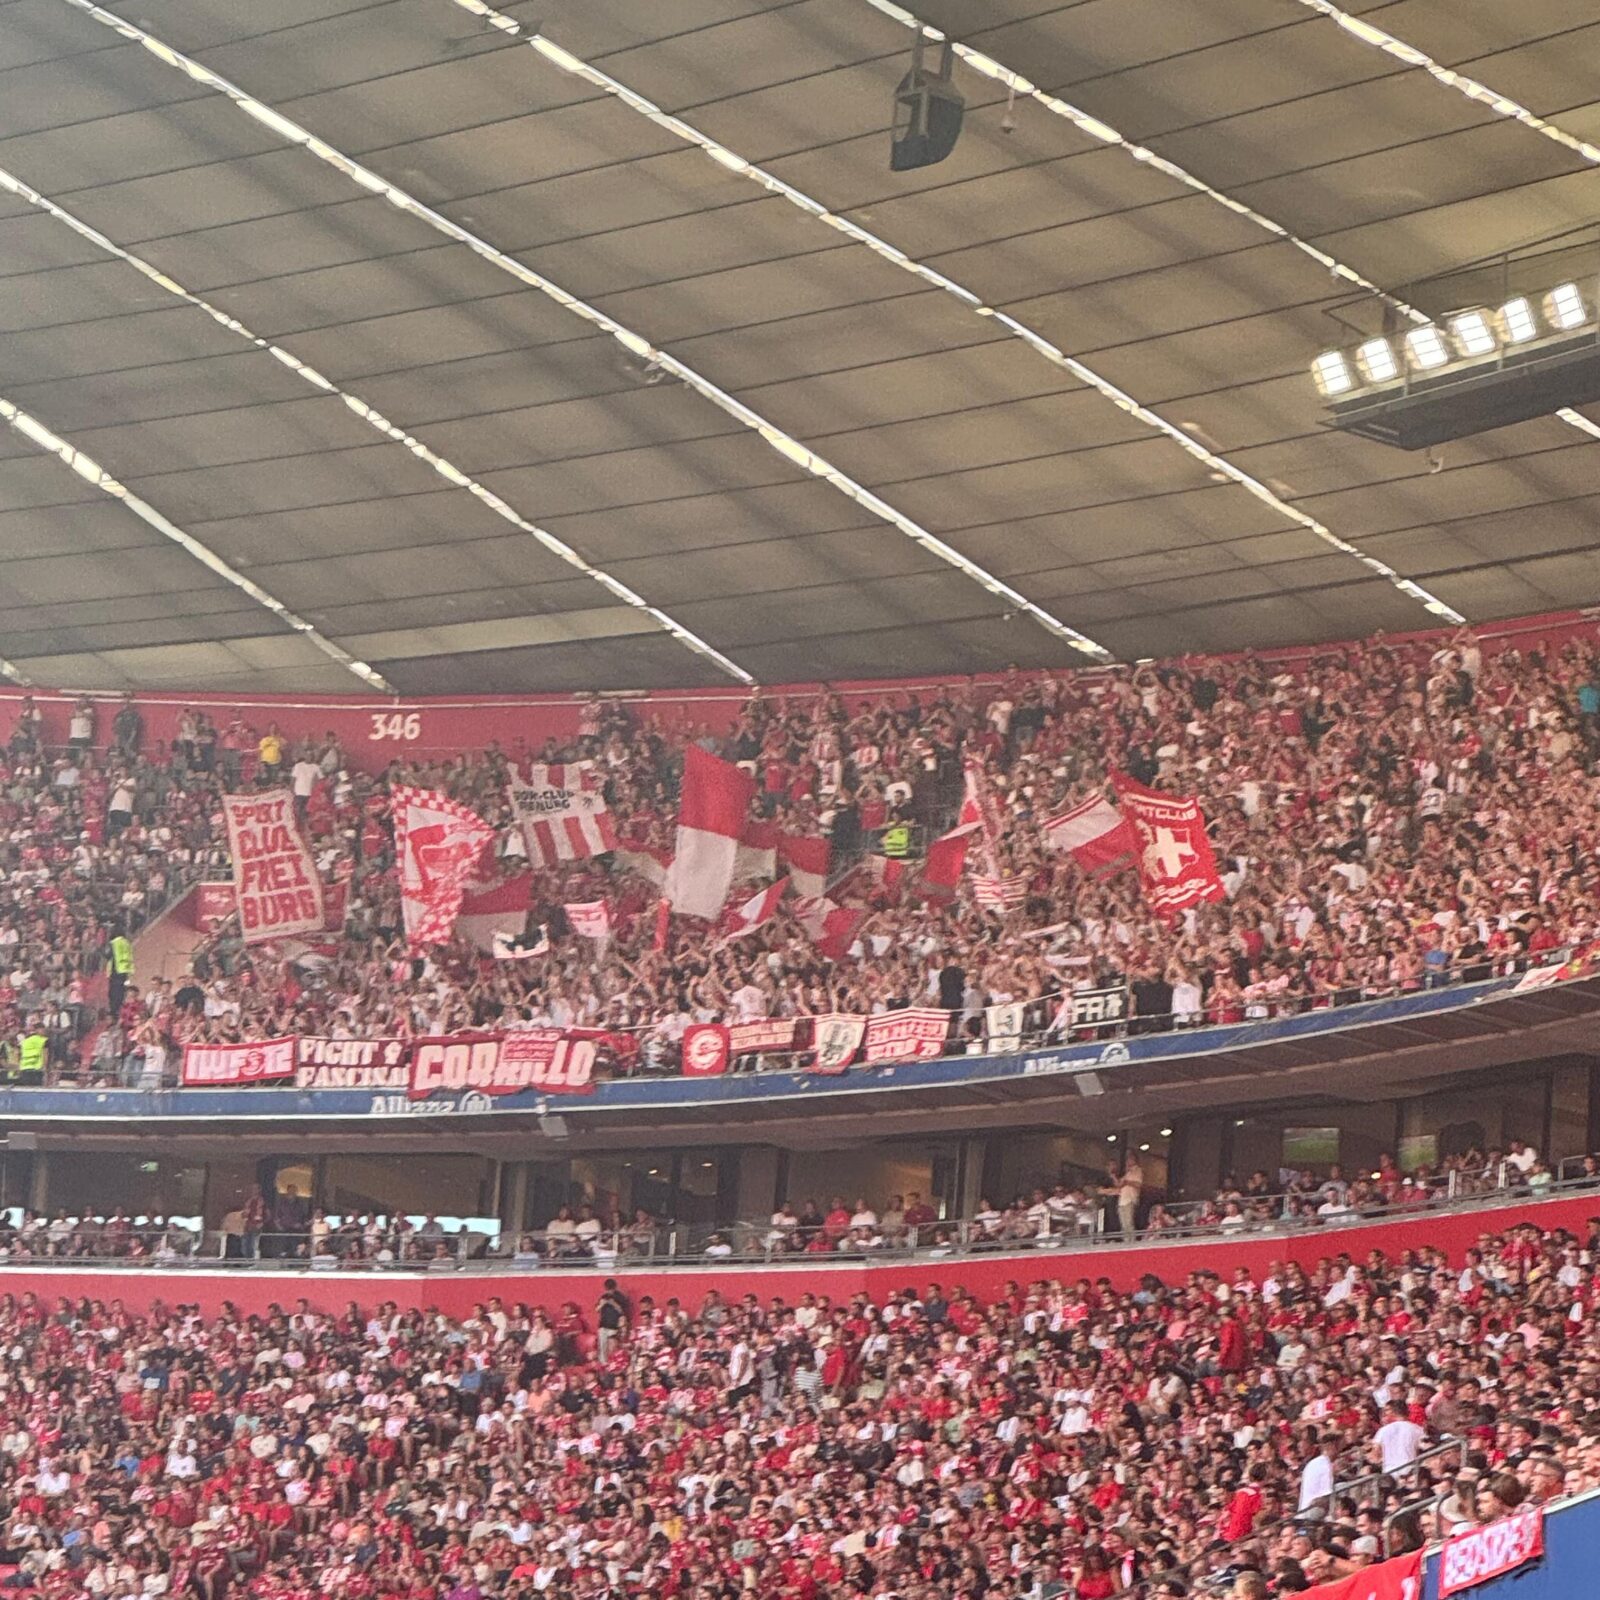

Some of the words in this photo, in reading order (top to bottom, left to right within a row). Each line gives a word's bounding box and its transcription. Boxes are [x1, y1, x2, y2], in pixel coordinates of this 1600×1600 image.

[368, 713, 421, 740] 346
[240, 853, 310, 895] FREI
[242, 890, 318, 930] BURG
[300, 1039, 379, 1065] FIGHT
